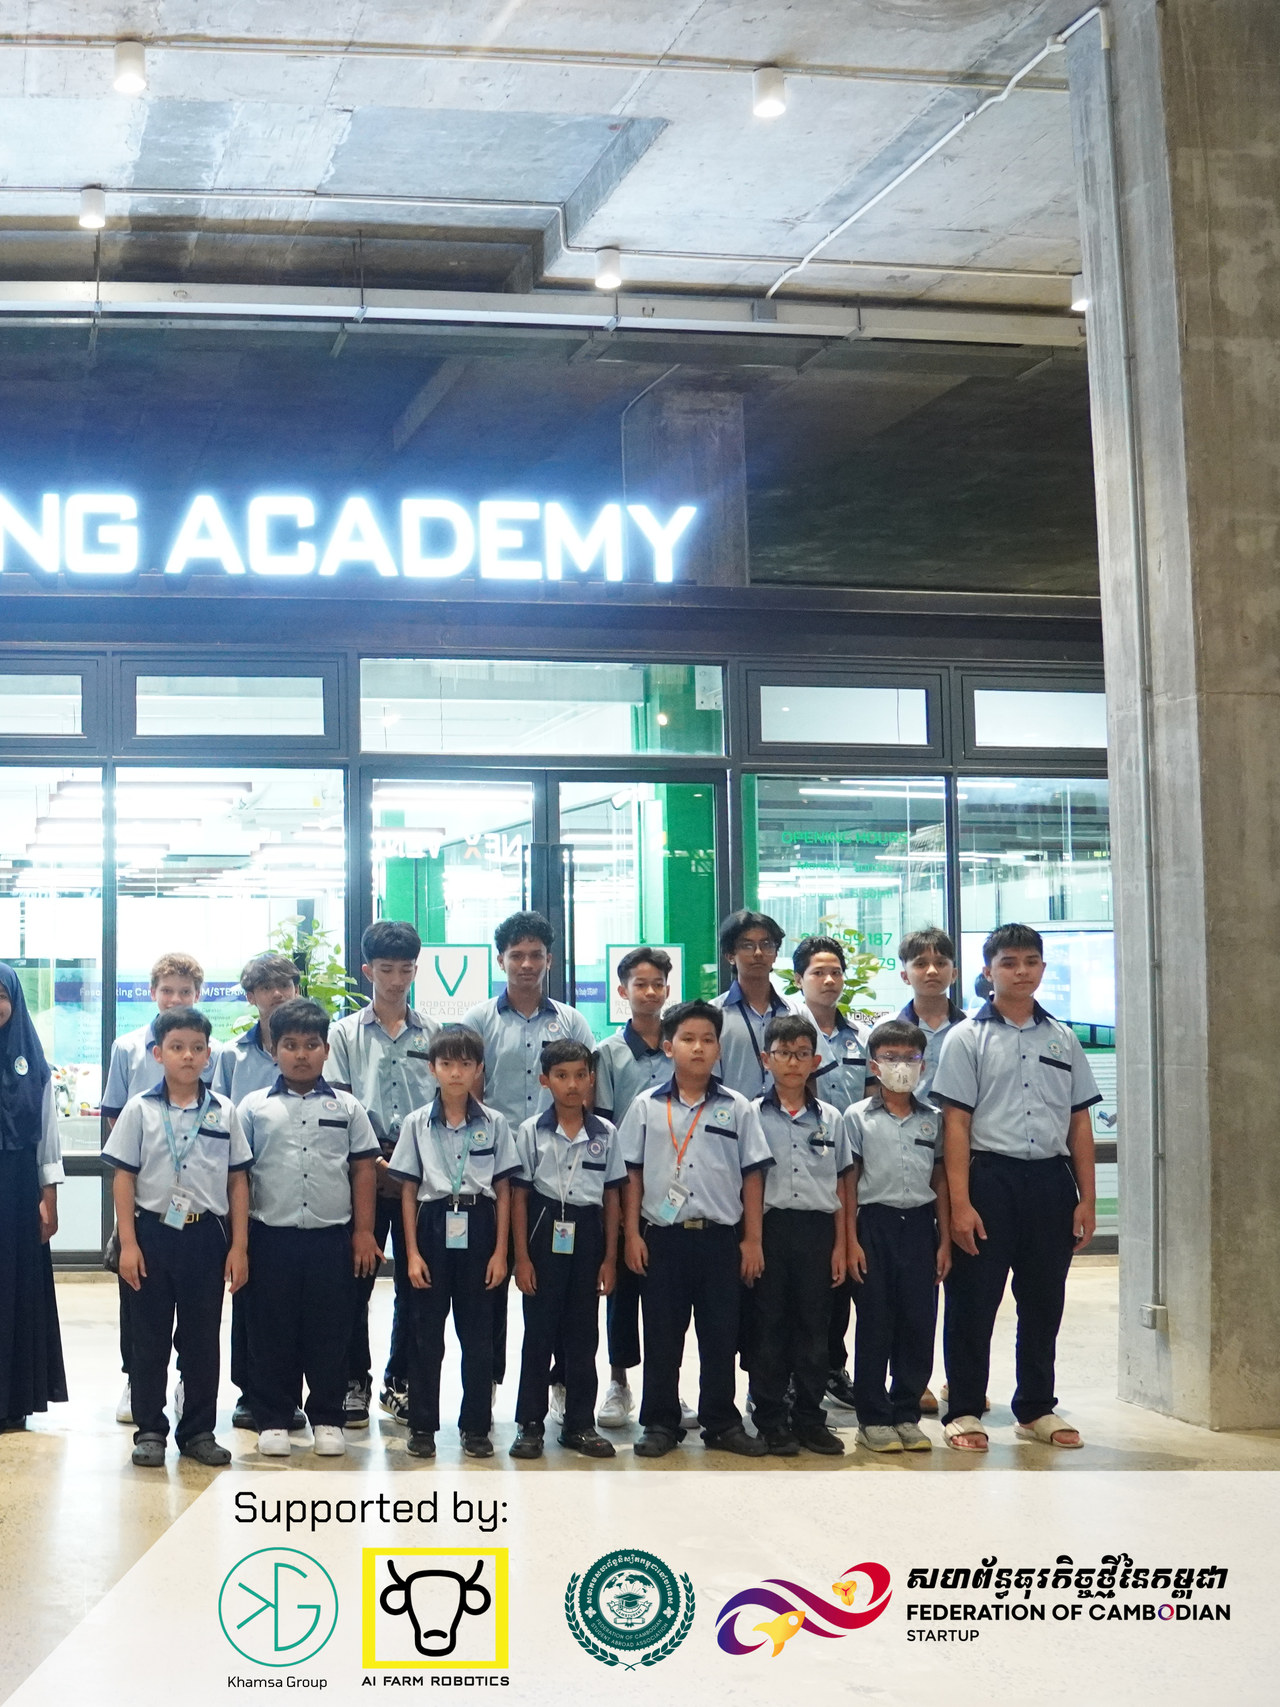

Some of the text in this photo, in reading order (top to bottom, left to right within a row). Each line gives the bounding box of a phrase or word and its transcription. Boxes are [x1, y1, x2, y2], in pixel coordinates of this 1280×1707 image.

[166, 494, 702, 585] ACADEMY
[782, 831, 908, 845] OPENING HOURS
[868, 932, 893, 946] 187
